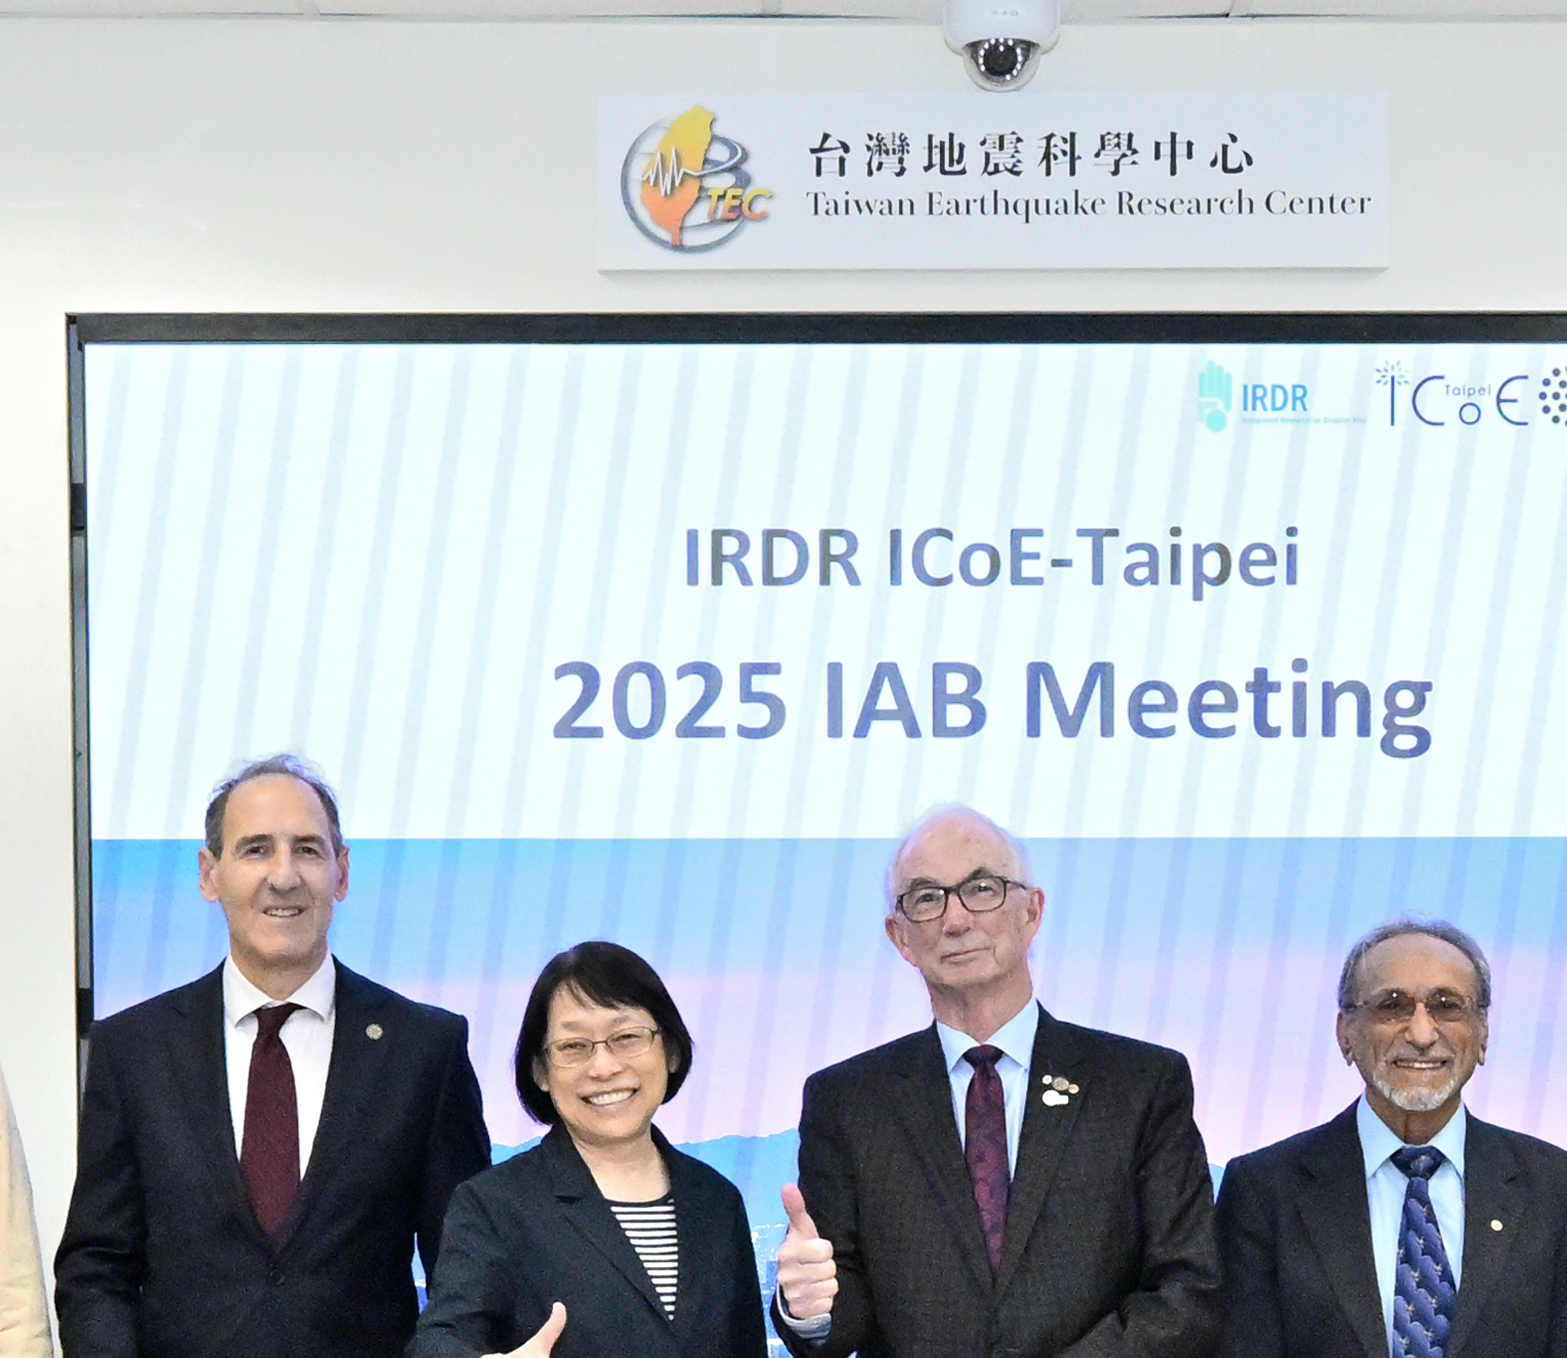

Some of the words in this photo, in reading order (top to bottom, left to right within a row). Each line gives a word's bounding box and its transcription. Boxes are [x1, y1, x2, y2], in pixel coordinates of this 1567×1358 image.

[808, 130, 1255, 178] 台灣地震科學中心
[707, 188, 774, 220] TEC
[806, 190, 916, 216] Taiwan
[928, 189, 1107, 224] Earthquake
[1118, 189, 1254, 216] Research
[1264, 190, 1372, 215] Center
[1242, 384, 1308, 412] IRDR
[1446, 384, 1491, 398] Taipei
[685, 528, 863, 587] IRDR
[889, 525, 1300, 602] ICoE-Taipei
[552, 660, 788, 740] 2025
[826, 661, 989, 740] IAB
[1025, 657, 1435, 761] Meeting
